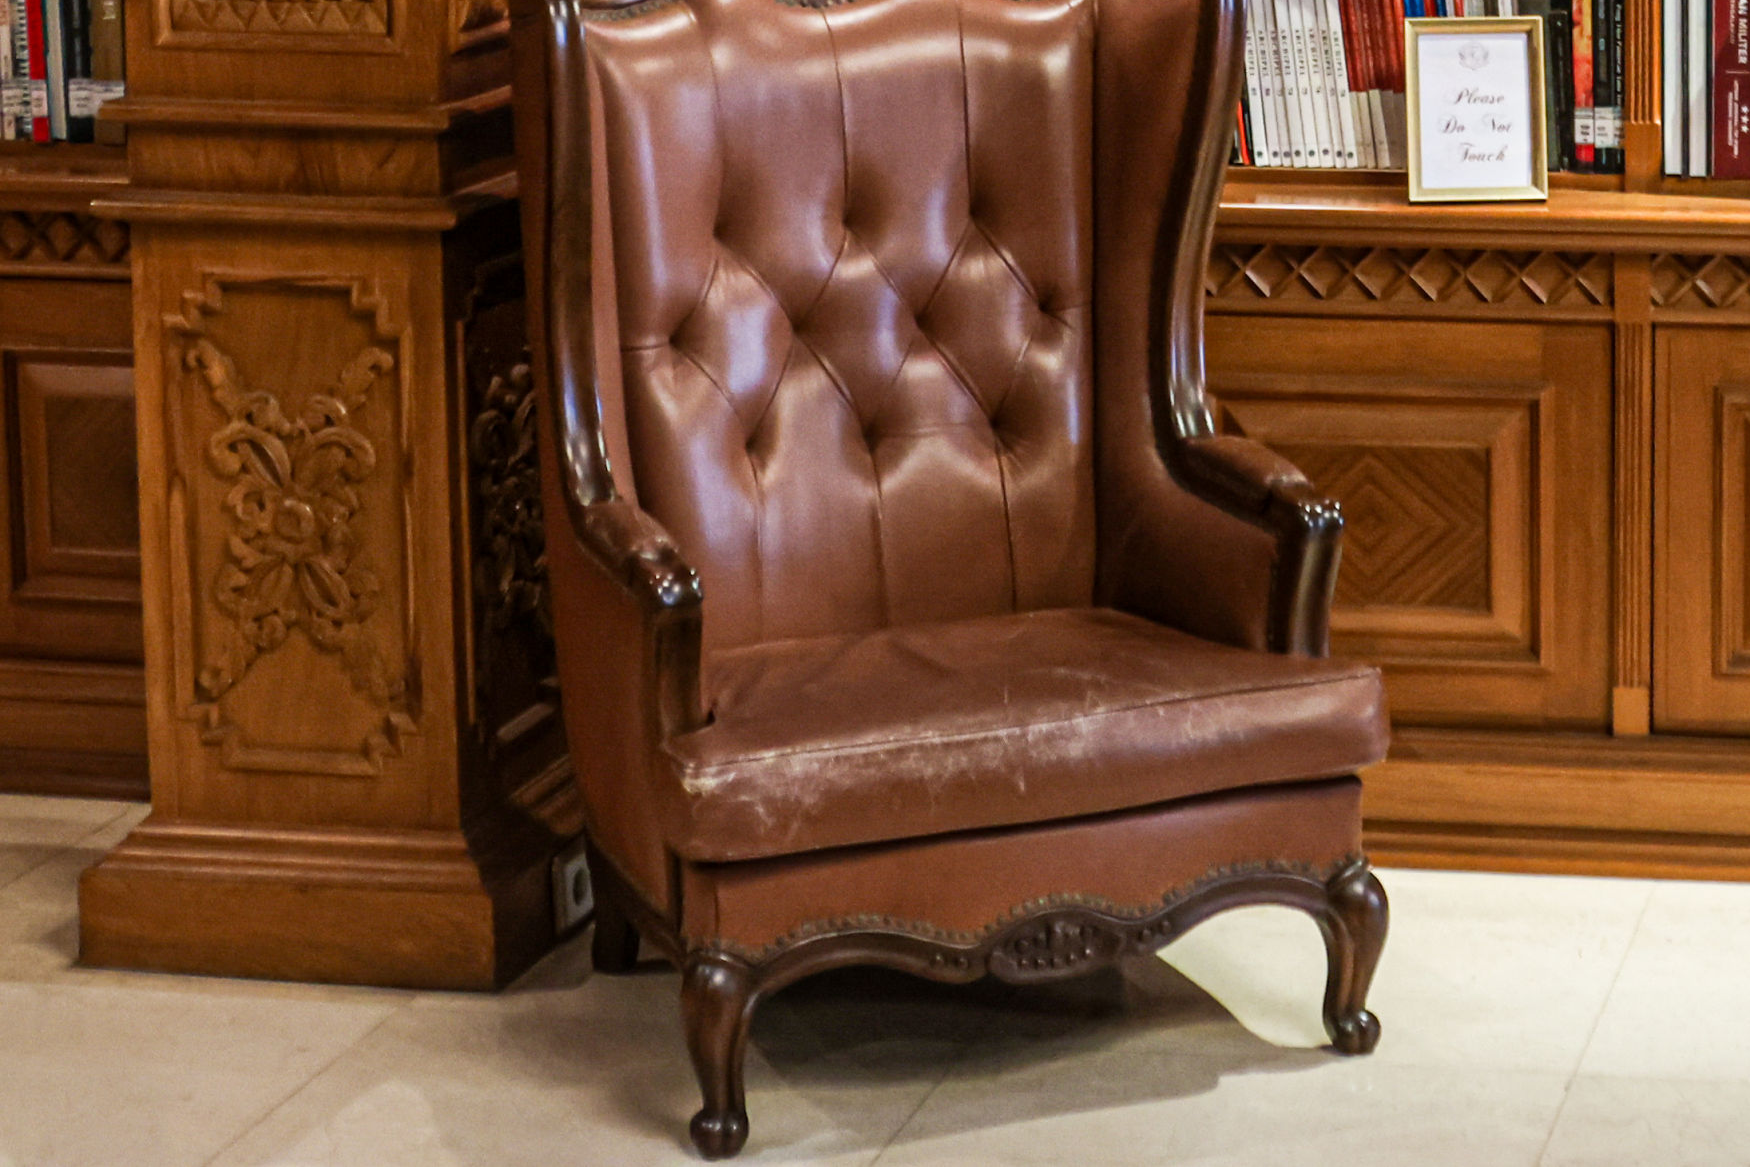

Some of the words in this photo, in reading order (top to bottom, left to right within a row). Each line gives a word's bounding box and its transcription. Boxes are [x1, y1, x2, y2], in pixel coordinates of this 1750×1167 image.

[1738, 17, 1750, 65] MILITER
[1453, 88, 1505, 105] Please
[1441, 114, 1466, 134] Do
[1483, 113, 1513, 133] Not
[1459, 142, 1509, 163] Touch
